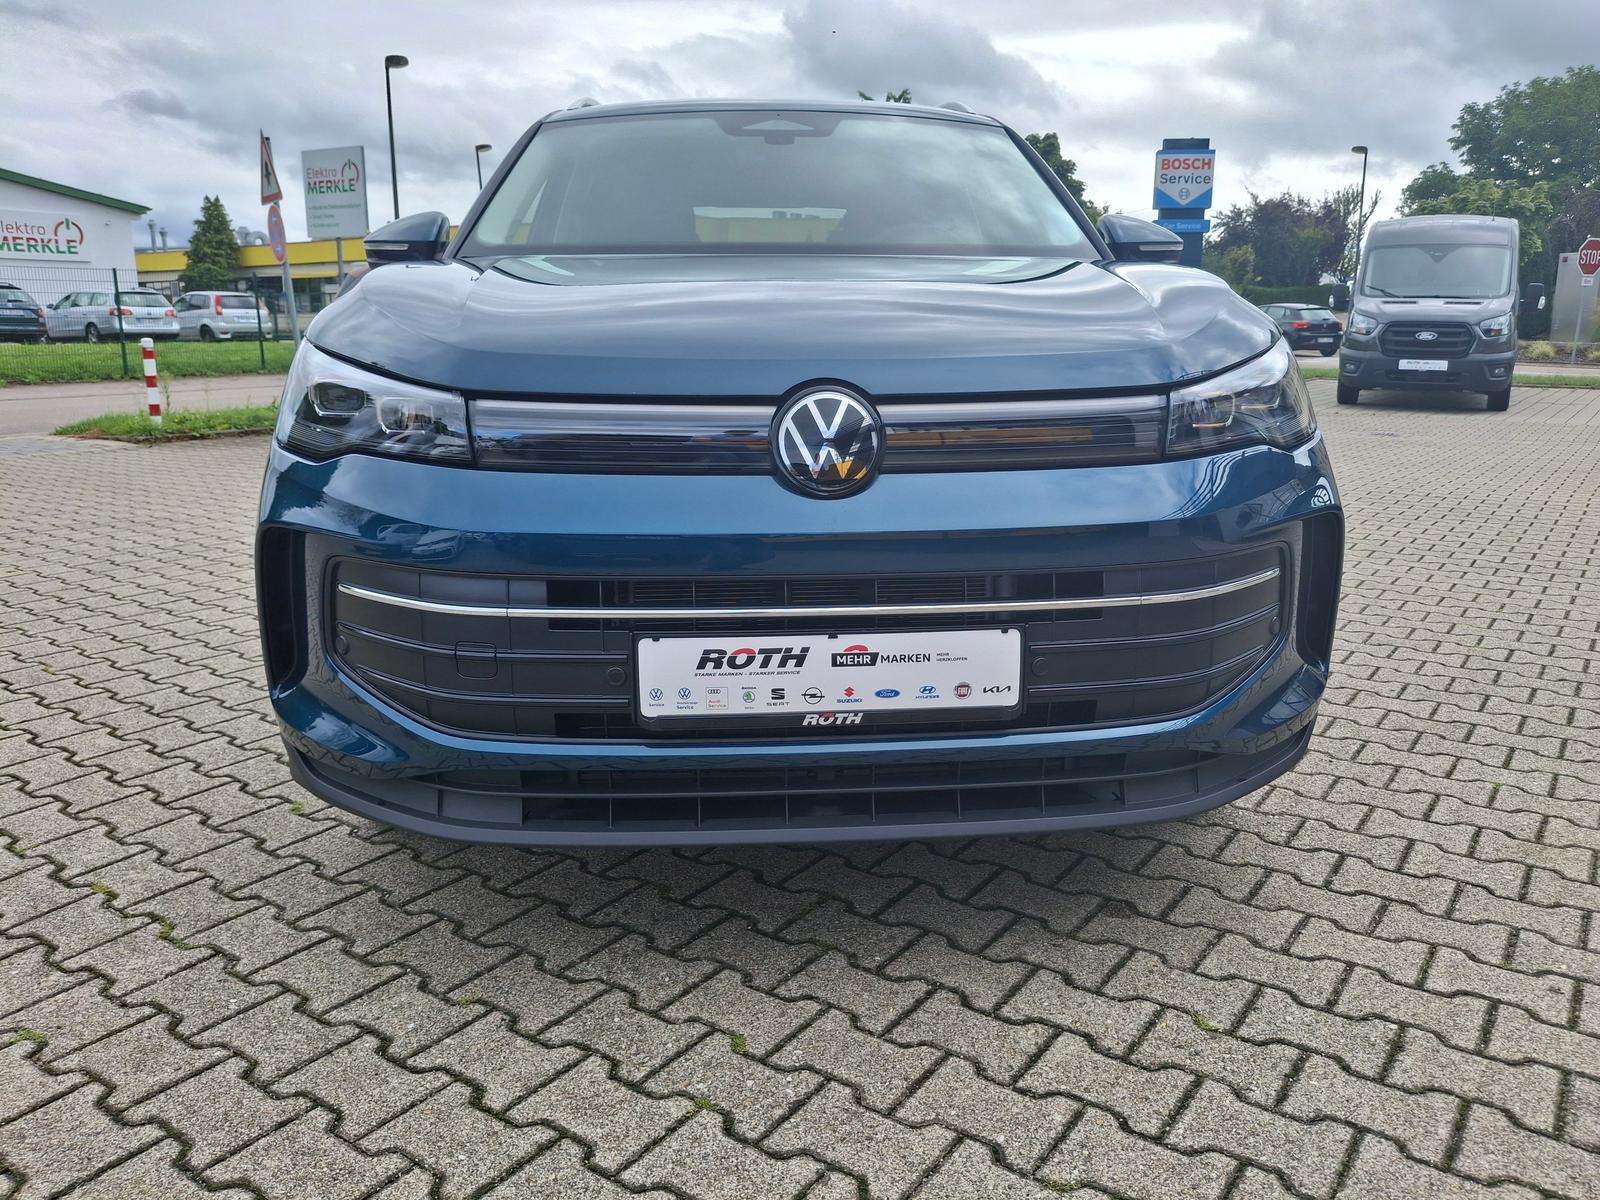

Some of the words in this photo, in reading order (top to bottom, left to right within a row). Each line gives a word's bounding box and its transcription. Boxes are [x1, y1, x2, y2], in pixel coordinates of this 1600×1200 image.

[1161, 158, 1211, 170] BOSCH
[306, 167, 336, 179] Elektro
[1160, 173, 1211, 184] Service
[307, 178, 356, 195] MERKLE
[0, 221, 46, 235] lektro
[696, 647, 811, 670] ROTH
[836, 655, 872, 665] MEHR
[880, 653, 931, 663] MARKEN
[802, 712, 863, 726] ROTH
